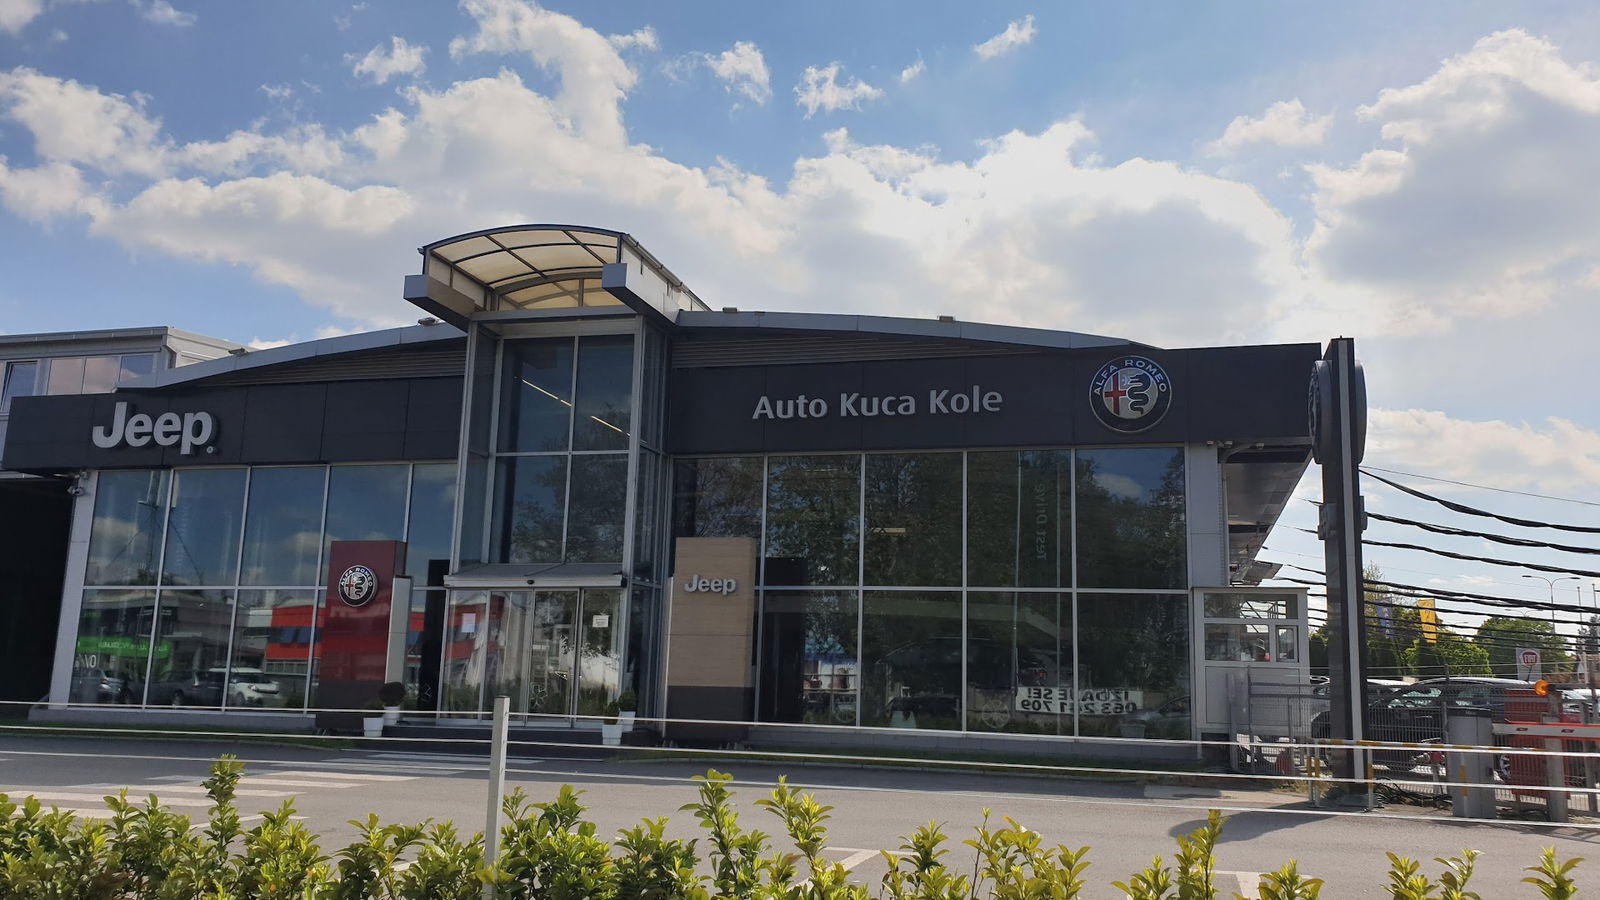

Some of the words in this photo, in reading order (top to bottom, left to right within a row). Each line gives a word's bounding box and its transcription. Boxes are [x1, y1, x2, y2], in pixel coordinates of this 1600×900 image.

[1093, 364, 1118, 396] ALFA
[1124, 359, 1167, 393] ROMEO
[752, 394, 828, 420] Auto
[840, 392, 916, 417] Kuca
[928, 384, 1003, 415] Kole
[92, 401, 213, 455] Jeep
[340, 569, 353, 586] ALFA
[355, 567, 373, 587] ROMEO
[684, 574, 737, 596] Jeep
